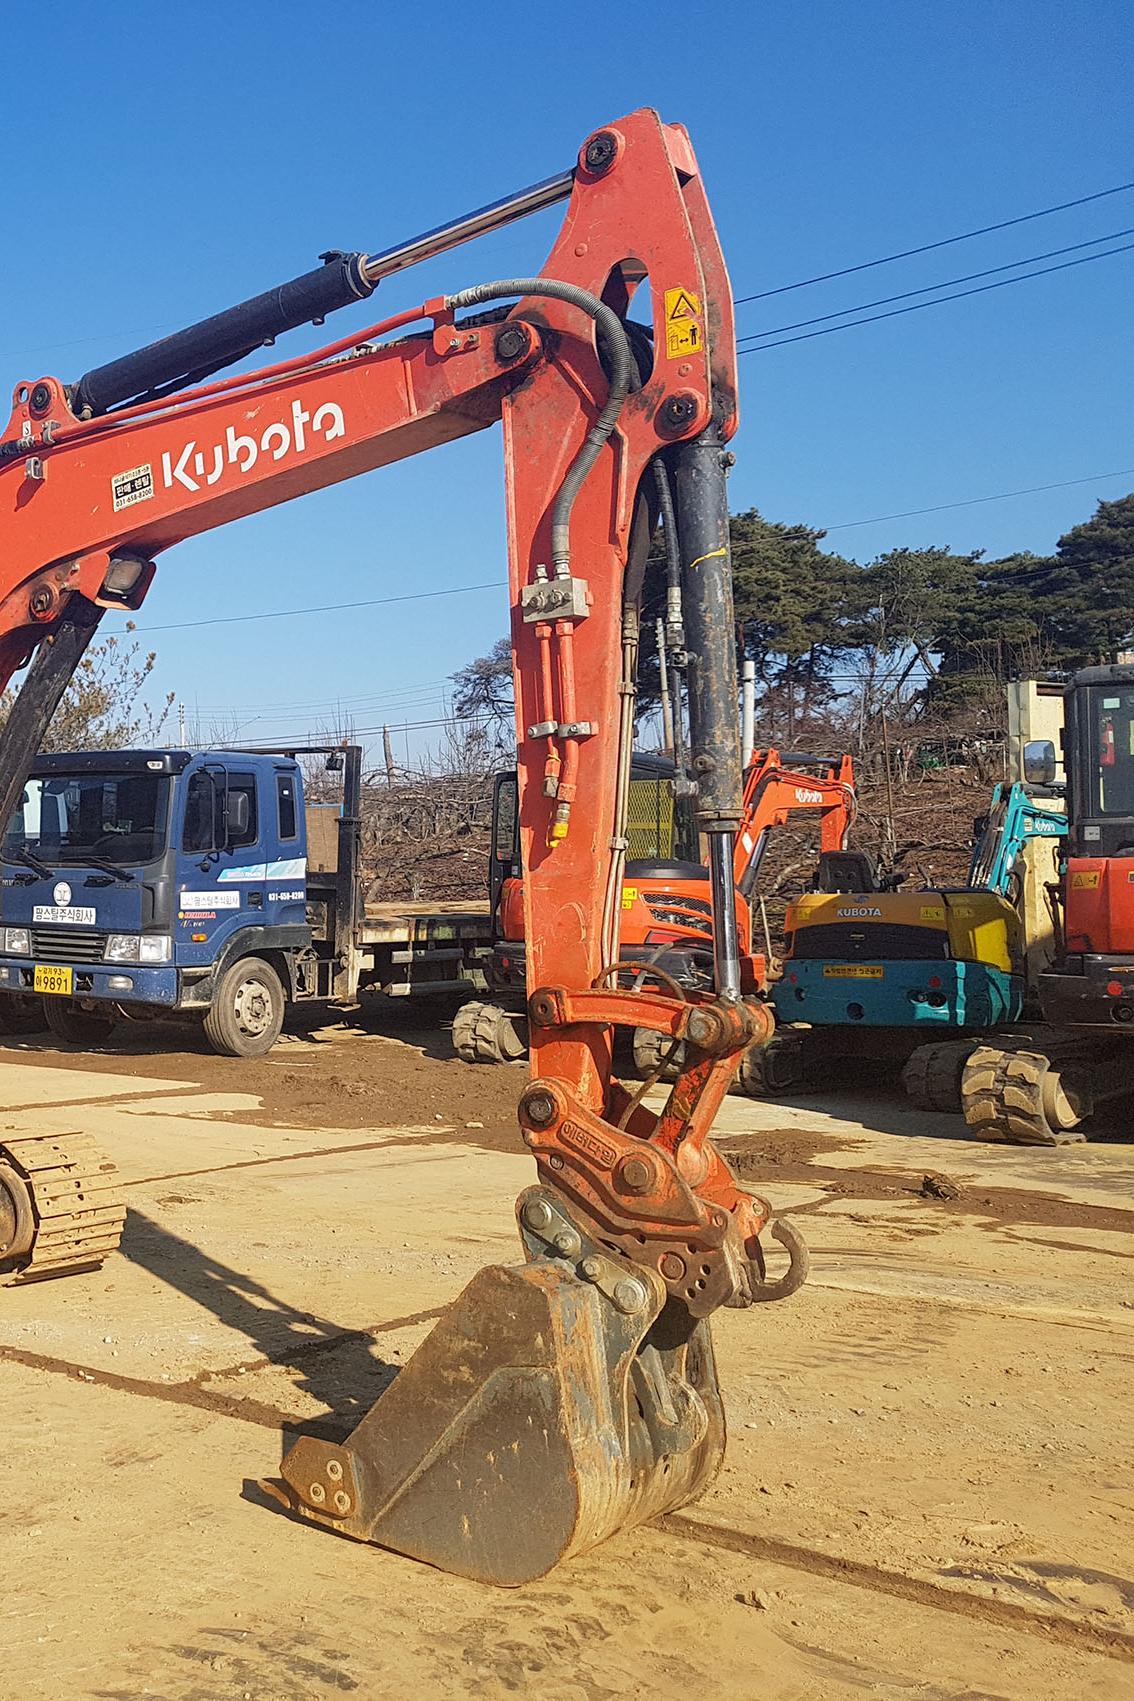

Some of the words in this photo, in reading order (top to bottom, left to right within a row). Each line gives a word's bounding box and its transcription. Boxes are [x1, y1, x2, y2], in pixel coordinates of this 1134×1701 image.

[162, 399, 345, 492] Kubota
[35, 907, 93, 923] 팜스틸주식회사
[836, 907, 882, 917] KUBOTA
